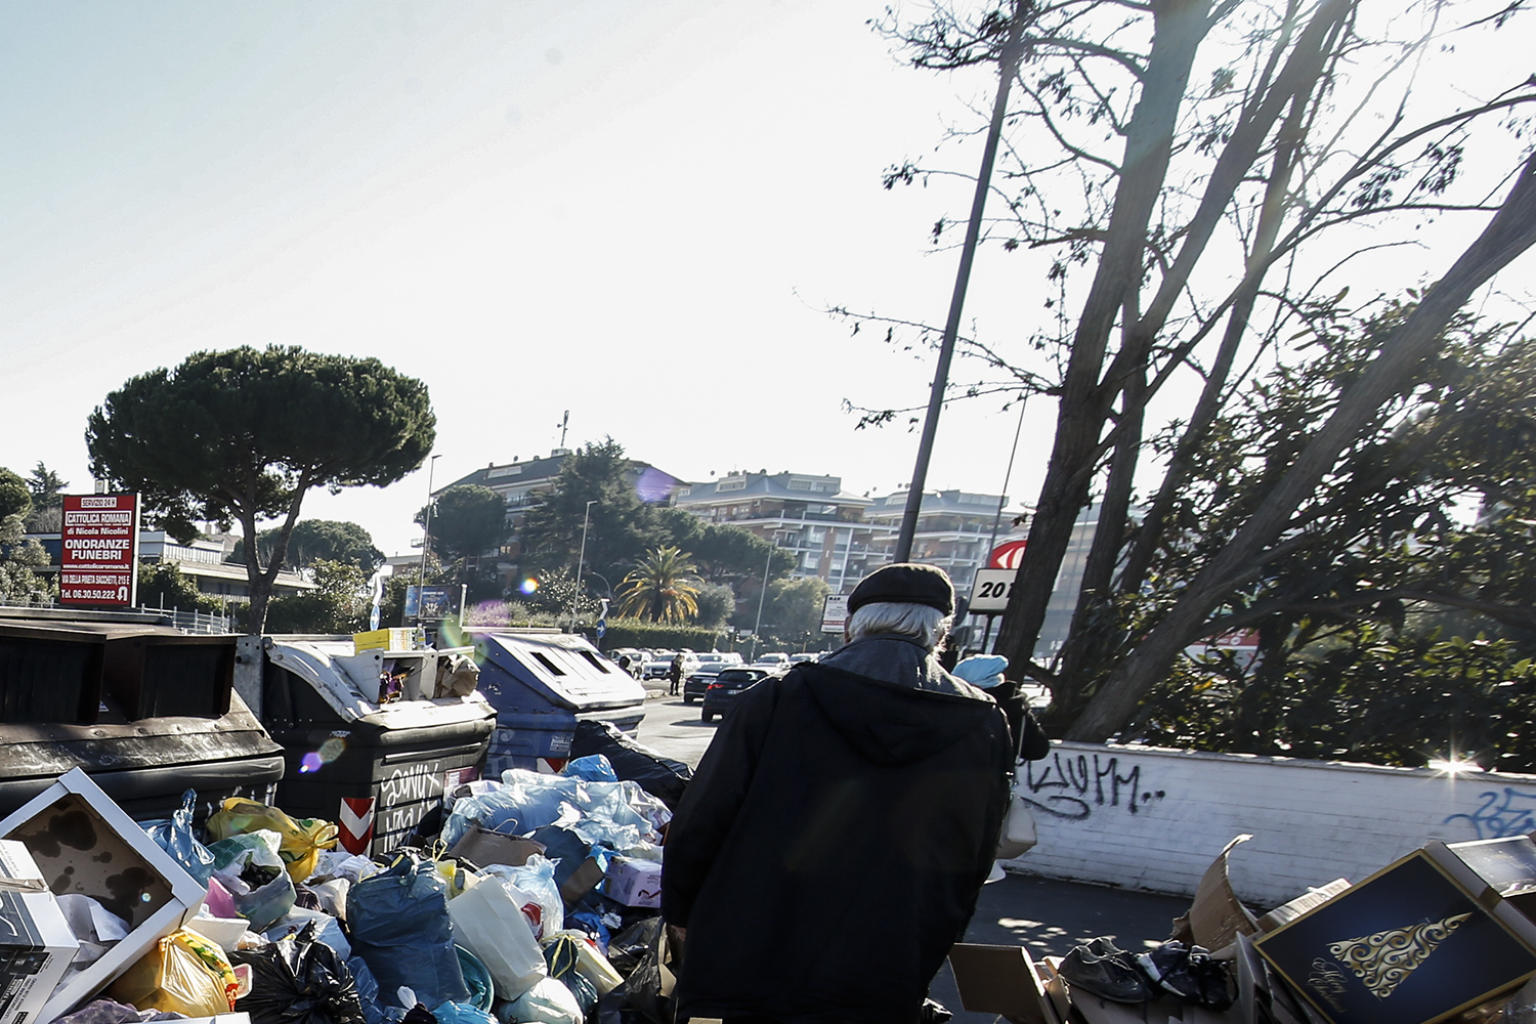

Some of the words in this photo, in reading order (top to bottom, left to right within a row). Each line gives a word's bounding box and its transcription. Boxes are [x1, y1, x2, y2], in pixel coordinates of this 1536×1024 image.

[68, 513, 100, 523] CATTOLICA
[101, 514, 129, 523] ROMANA
[67, 527, 74, 535] di
[75, 527, 99, 535] Nicola
[100, 527, 129, 535] Nicolini
[65, 539, 130, 550] ONORANZE
[71, 550, 122, 560] FUNEBRI
[73, 590, 116, 599] 06.30.50.222
